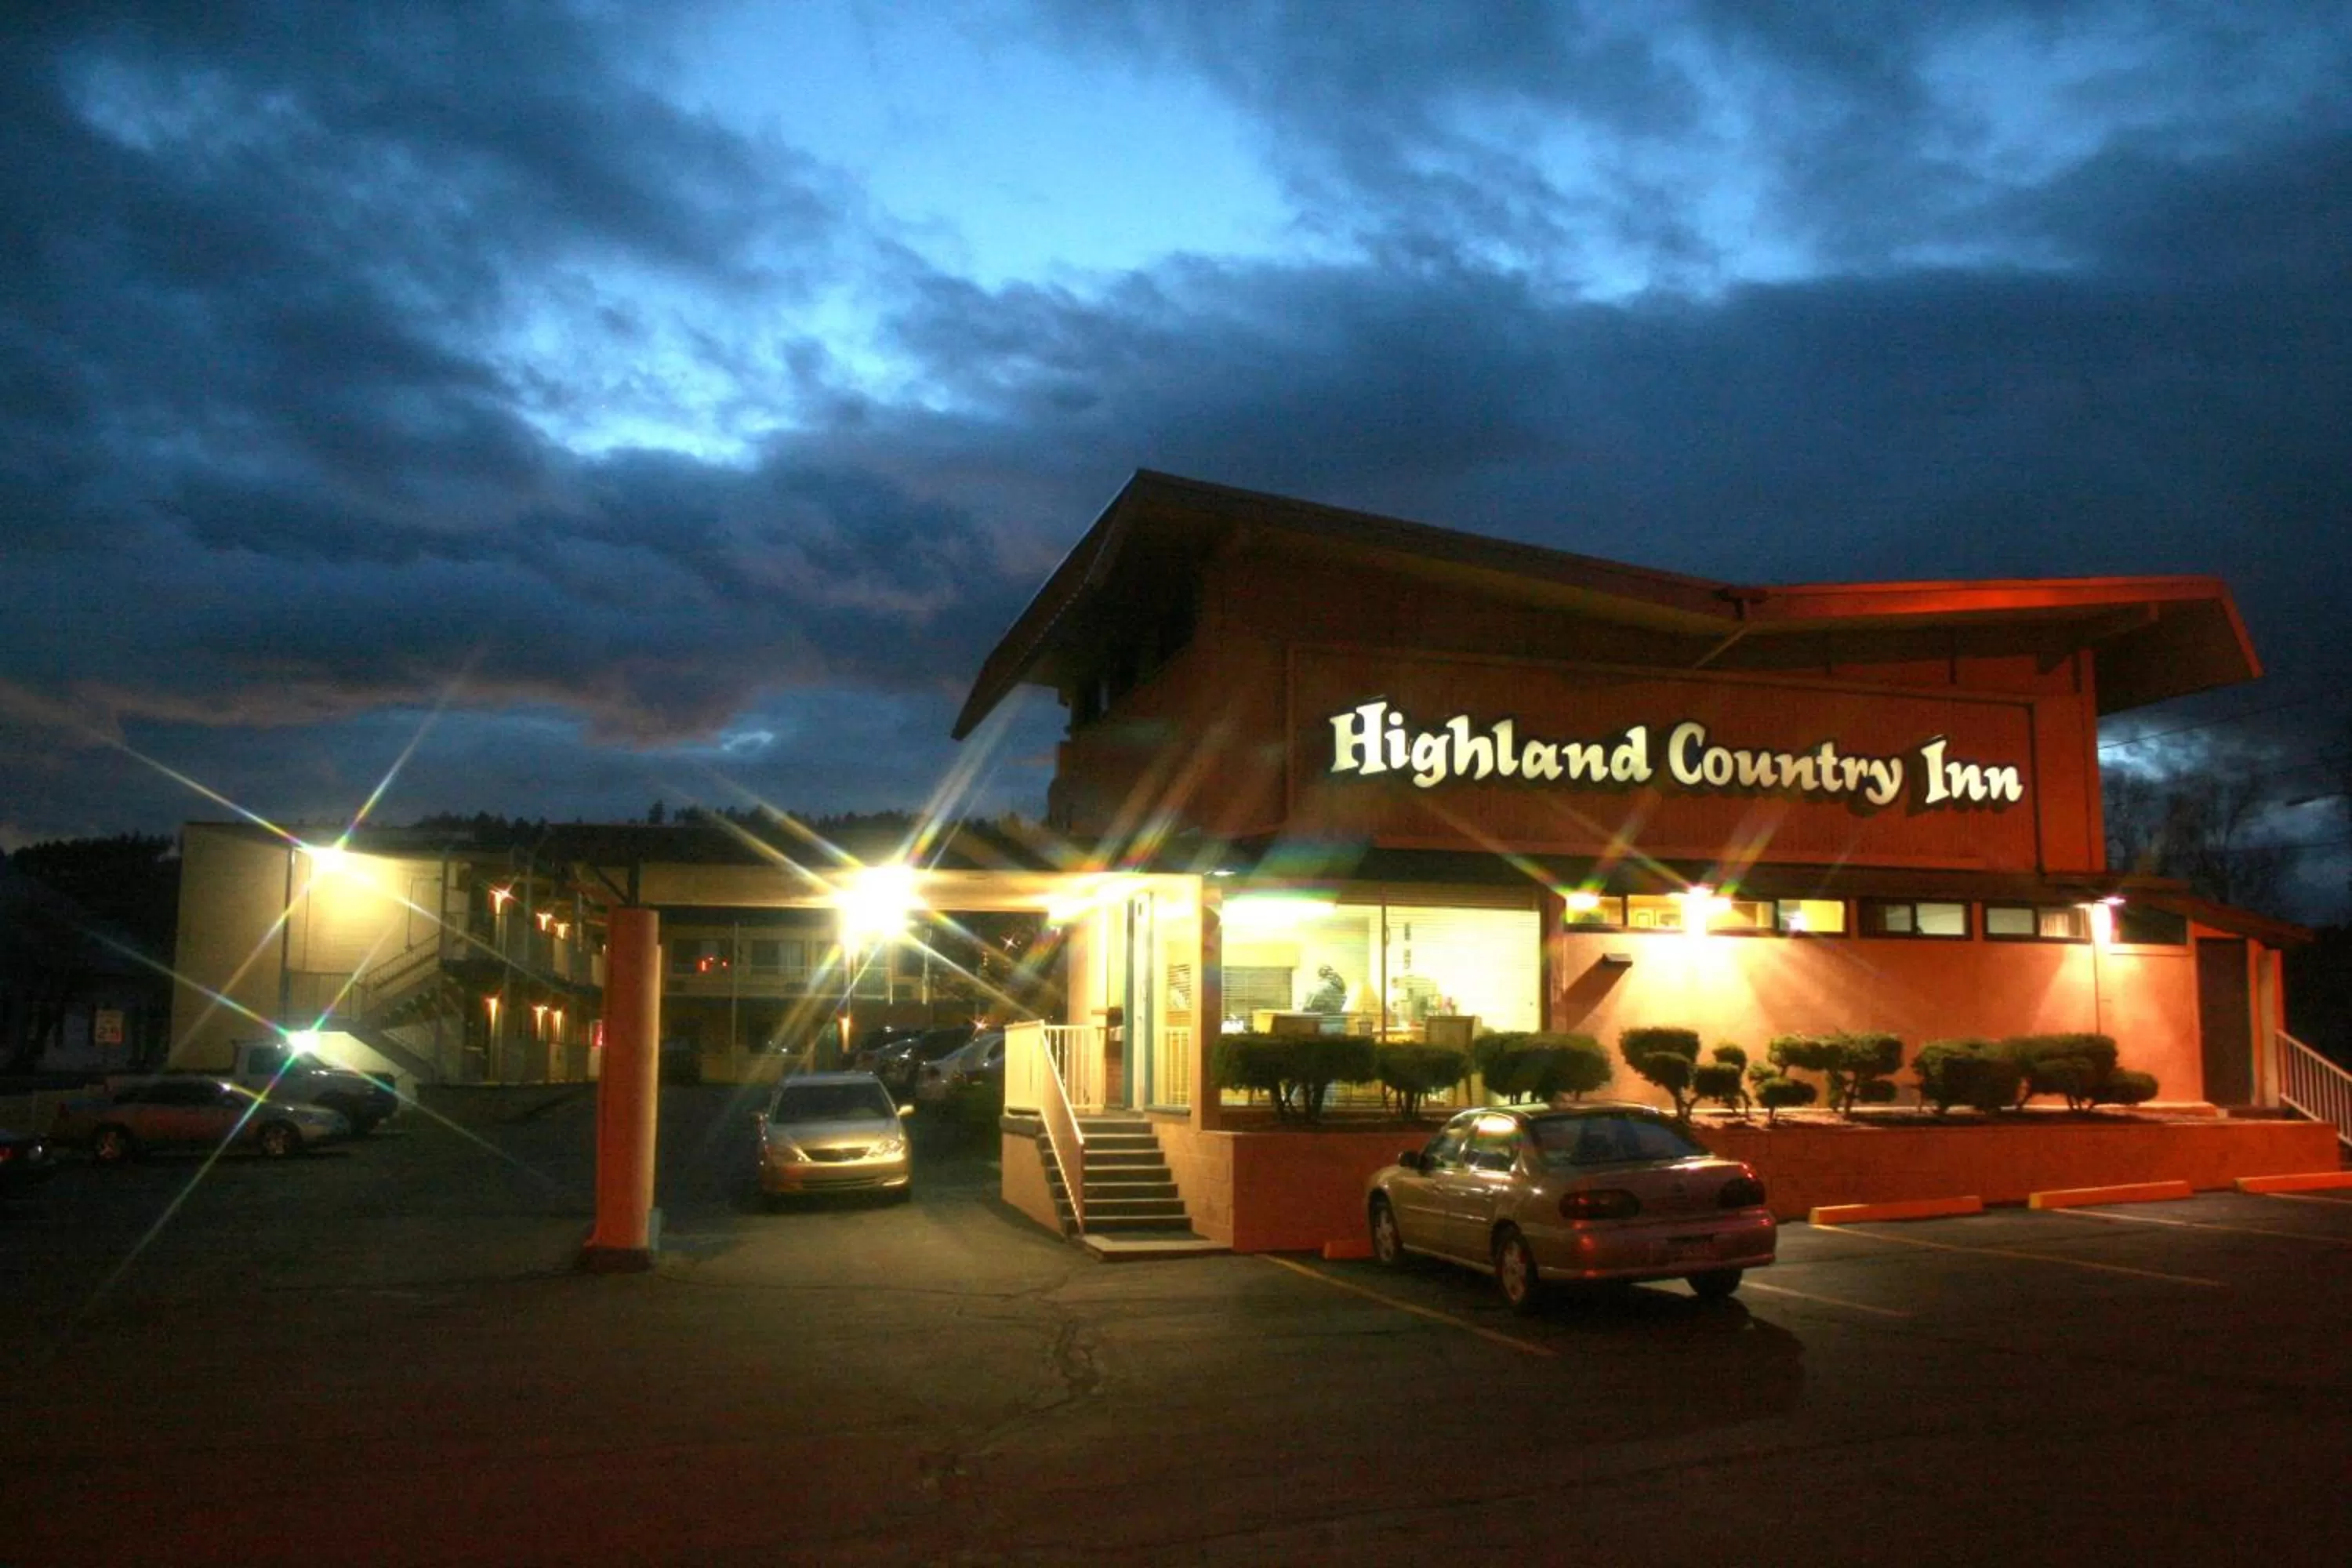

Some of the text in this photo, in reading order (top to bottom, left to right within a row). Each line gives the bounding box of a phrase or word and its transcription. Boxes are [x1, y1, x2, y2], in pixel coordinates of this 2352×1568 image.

[1329, 701, 2023, 804] Highland Country Inn
